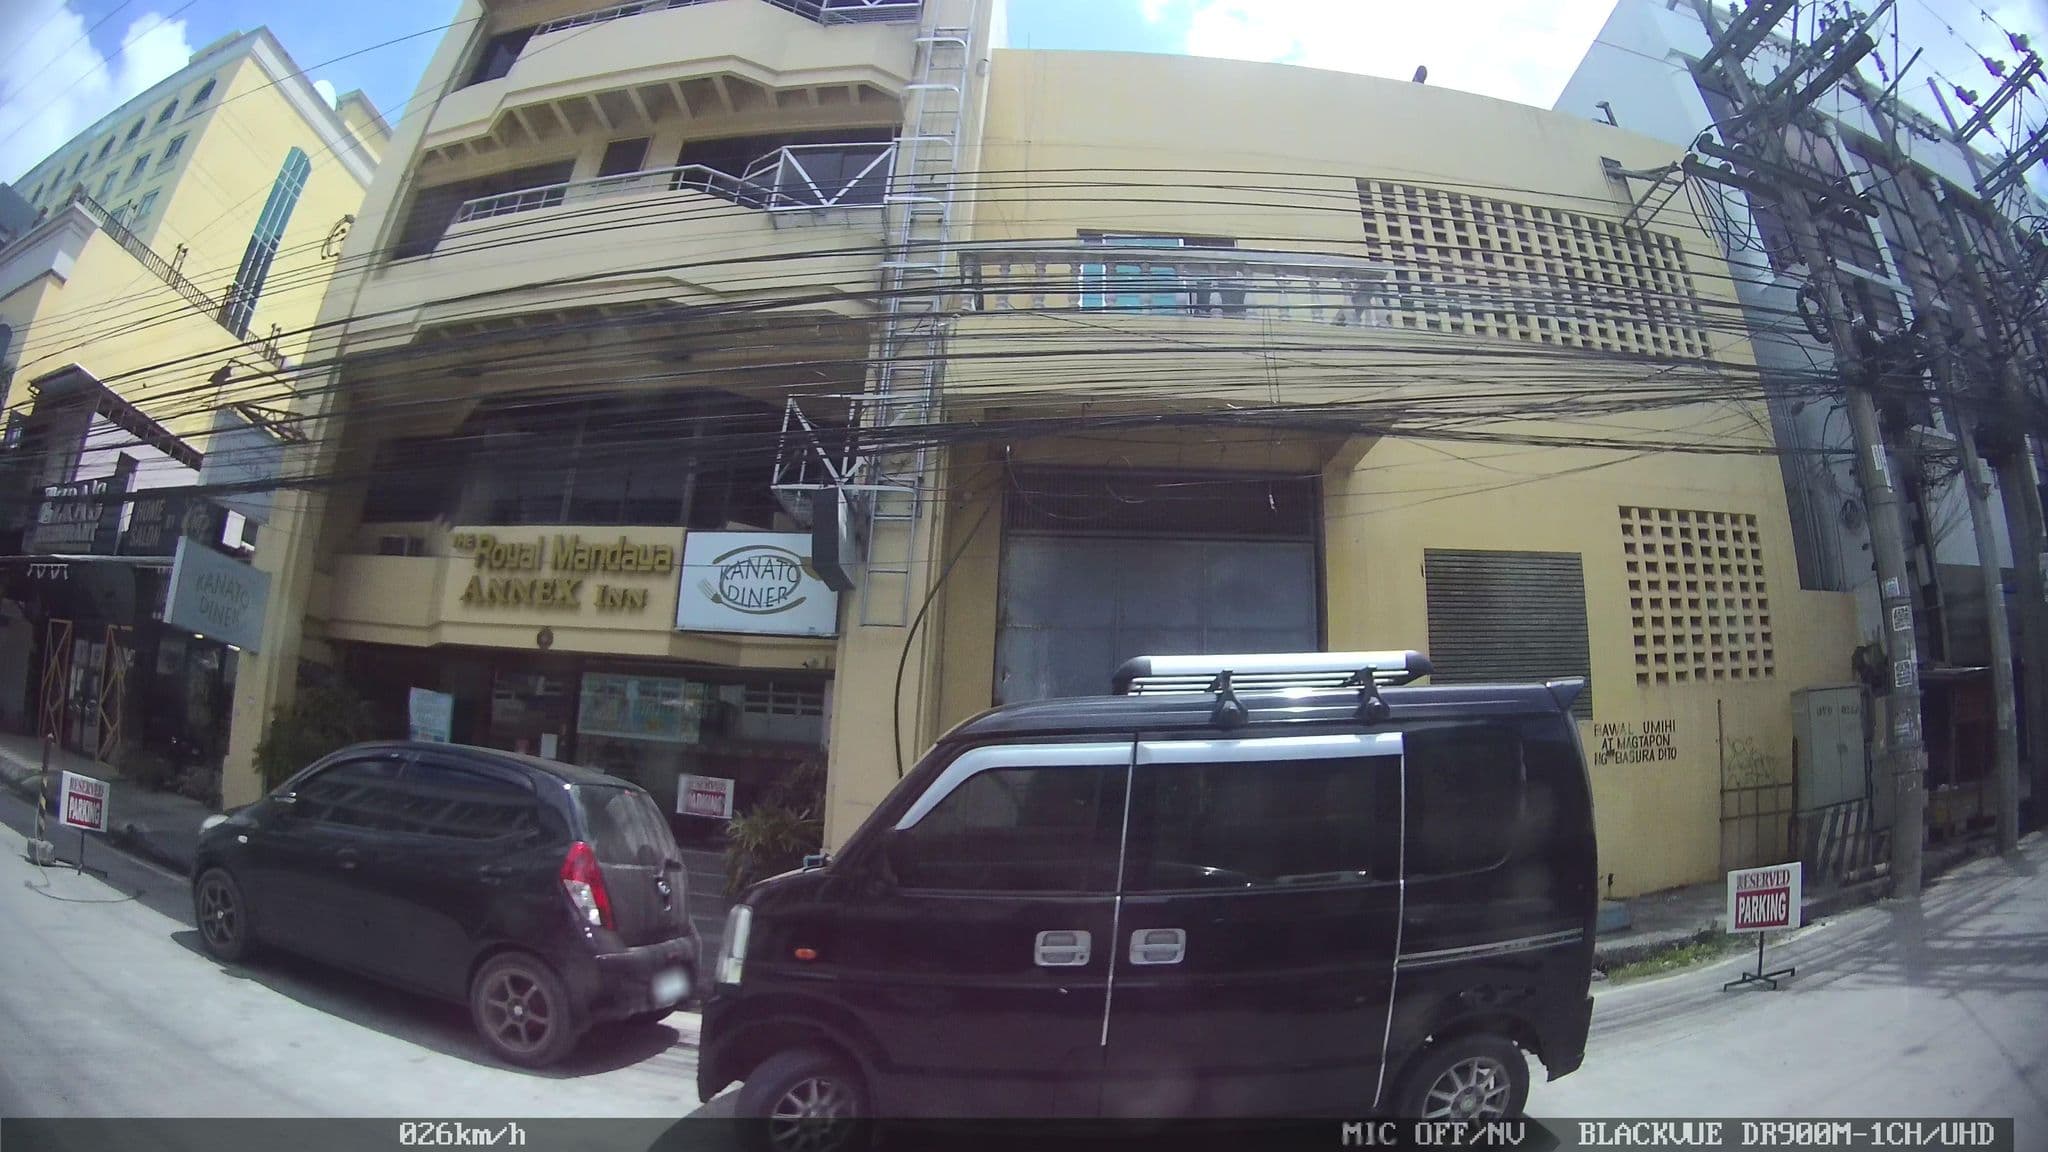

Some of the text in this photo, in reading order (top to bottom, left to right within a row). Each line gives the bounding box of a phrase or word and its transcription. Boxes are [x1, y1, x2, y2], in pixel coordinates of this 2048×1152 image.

[475, 533, 546, 569] Royal
[551, 534, 675, 574] Mandaya
[720, 555, 801, 583] KANATO
[460, 574, 583, 608] ANNEX
[727, 585, 789, 608] DINER
[1643, 719, 1676, 734] UMIHI
[1602, 734, 1671, 750] AT MAGTAPON
[1615, 748, 1655, 764] BASURA
[1658, 747, 1677, 760] DITO
[68, 796, 101, 825] PARKING
[1737, 869, 1790, 889] RESERVED
[1738, 892, 1787, 923] PARKING
